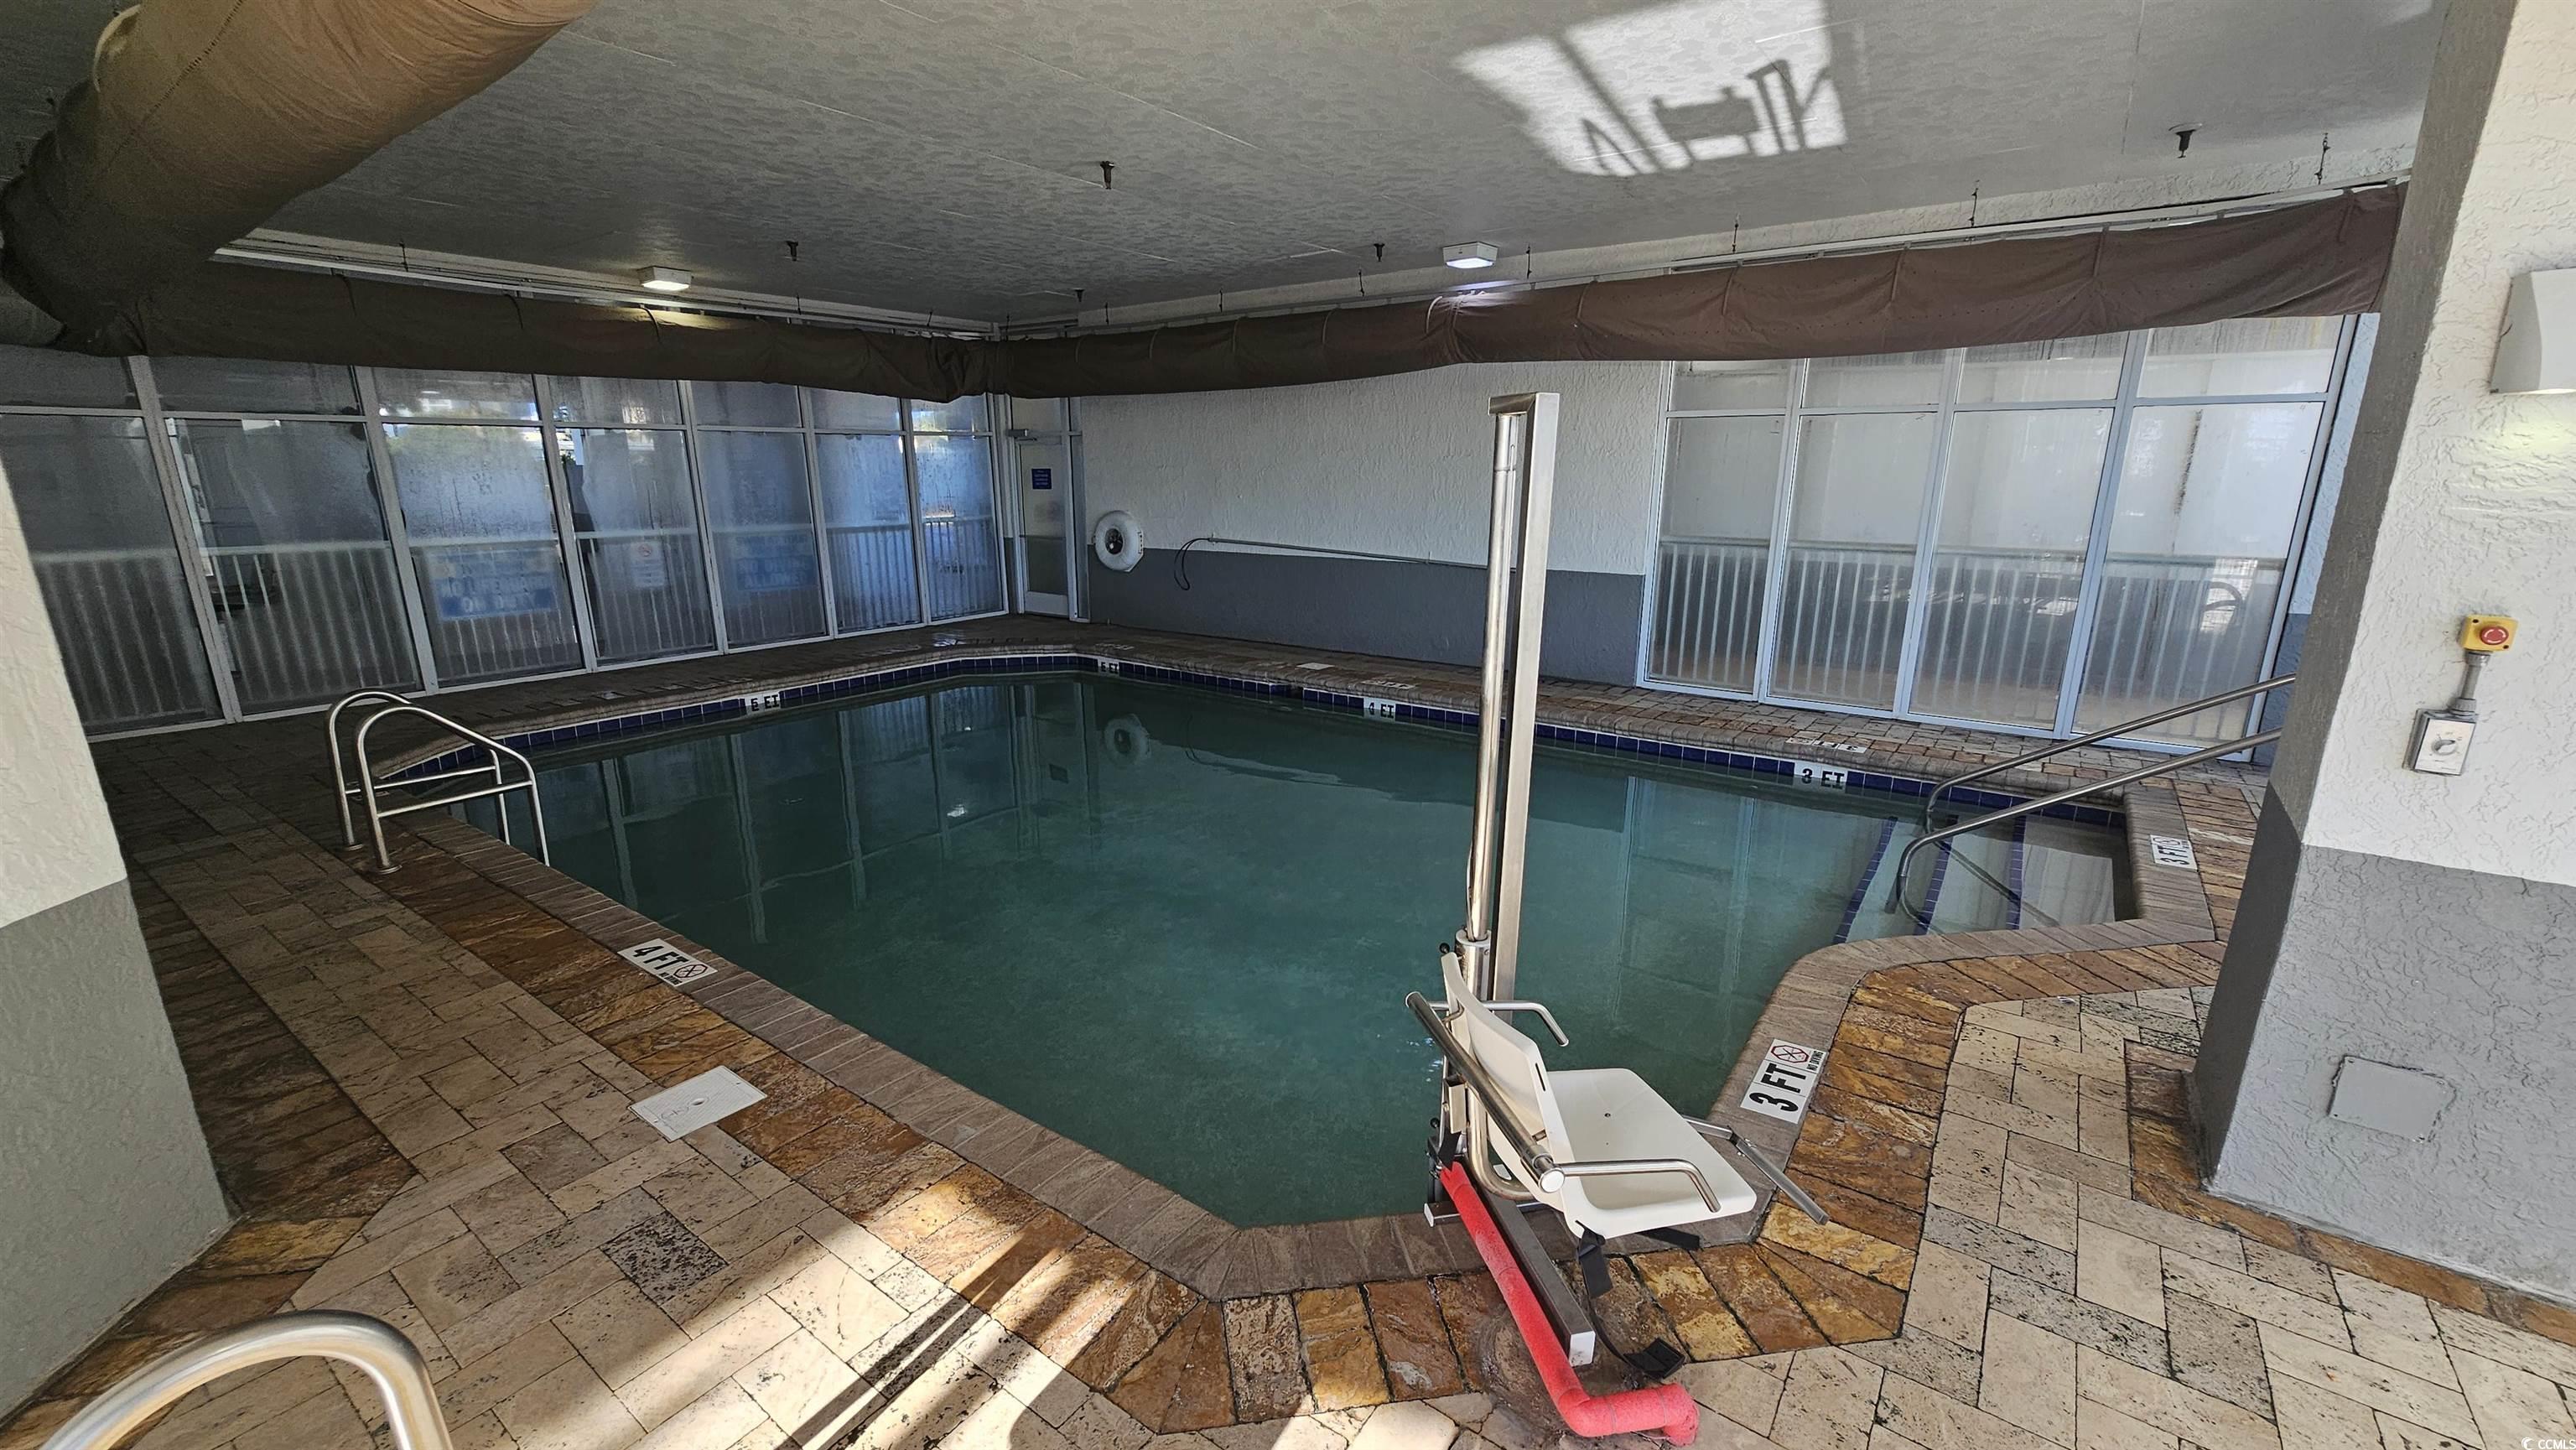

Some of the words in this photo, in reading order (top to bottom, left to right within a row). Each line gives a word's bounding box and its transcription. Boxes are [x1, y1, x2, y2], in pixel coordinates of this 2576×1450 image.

[2158, 845, 2188, 858] FT
[633, 945, 664, 957] 4
[643, 951, 689, 970] FT
[1761, 1063, 1806, 1094] FT
[1749, 1092, 1799, 1112] 3
